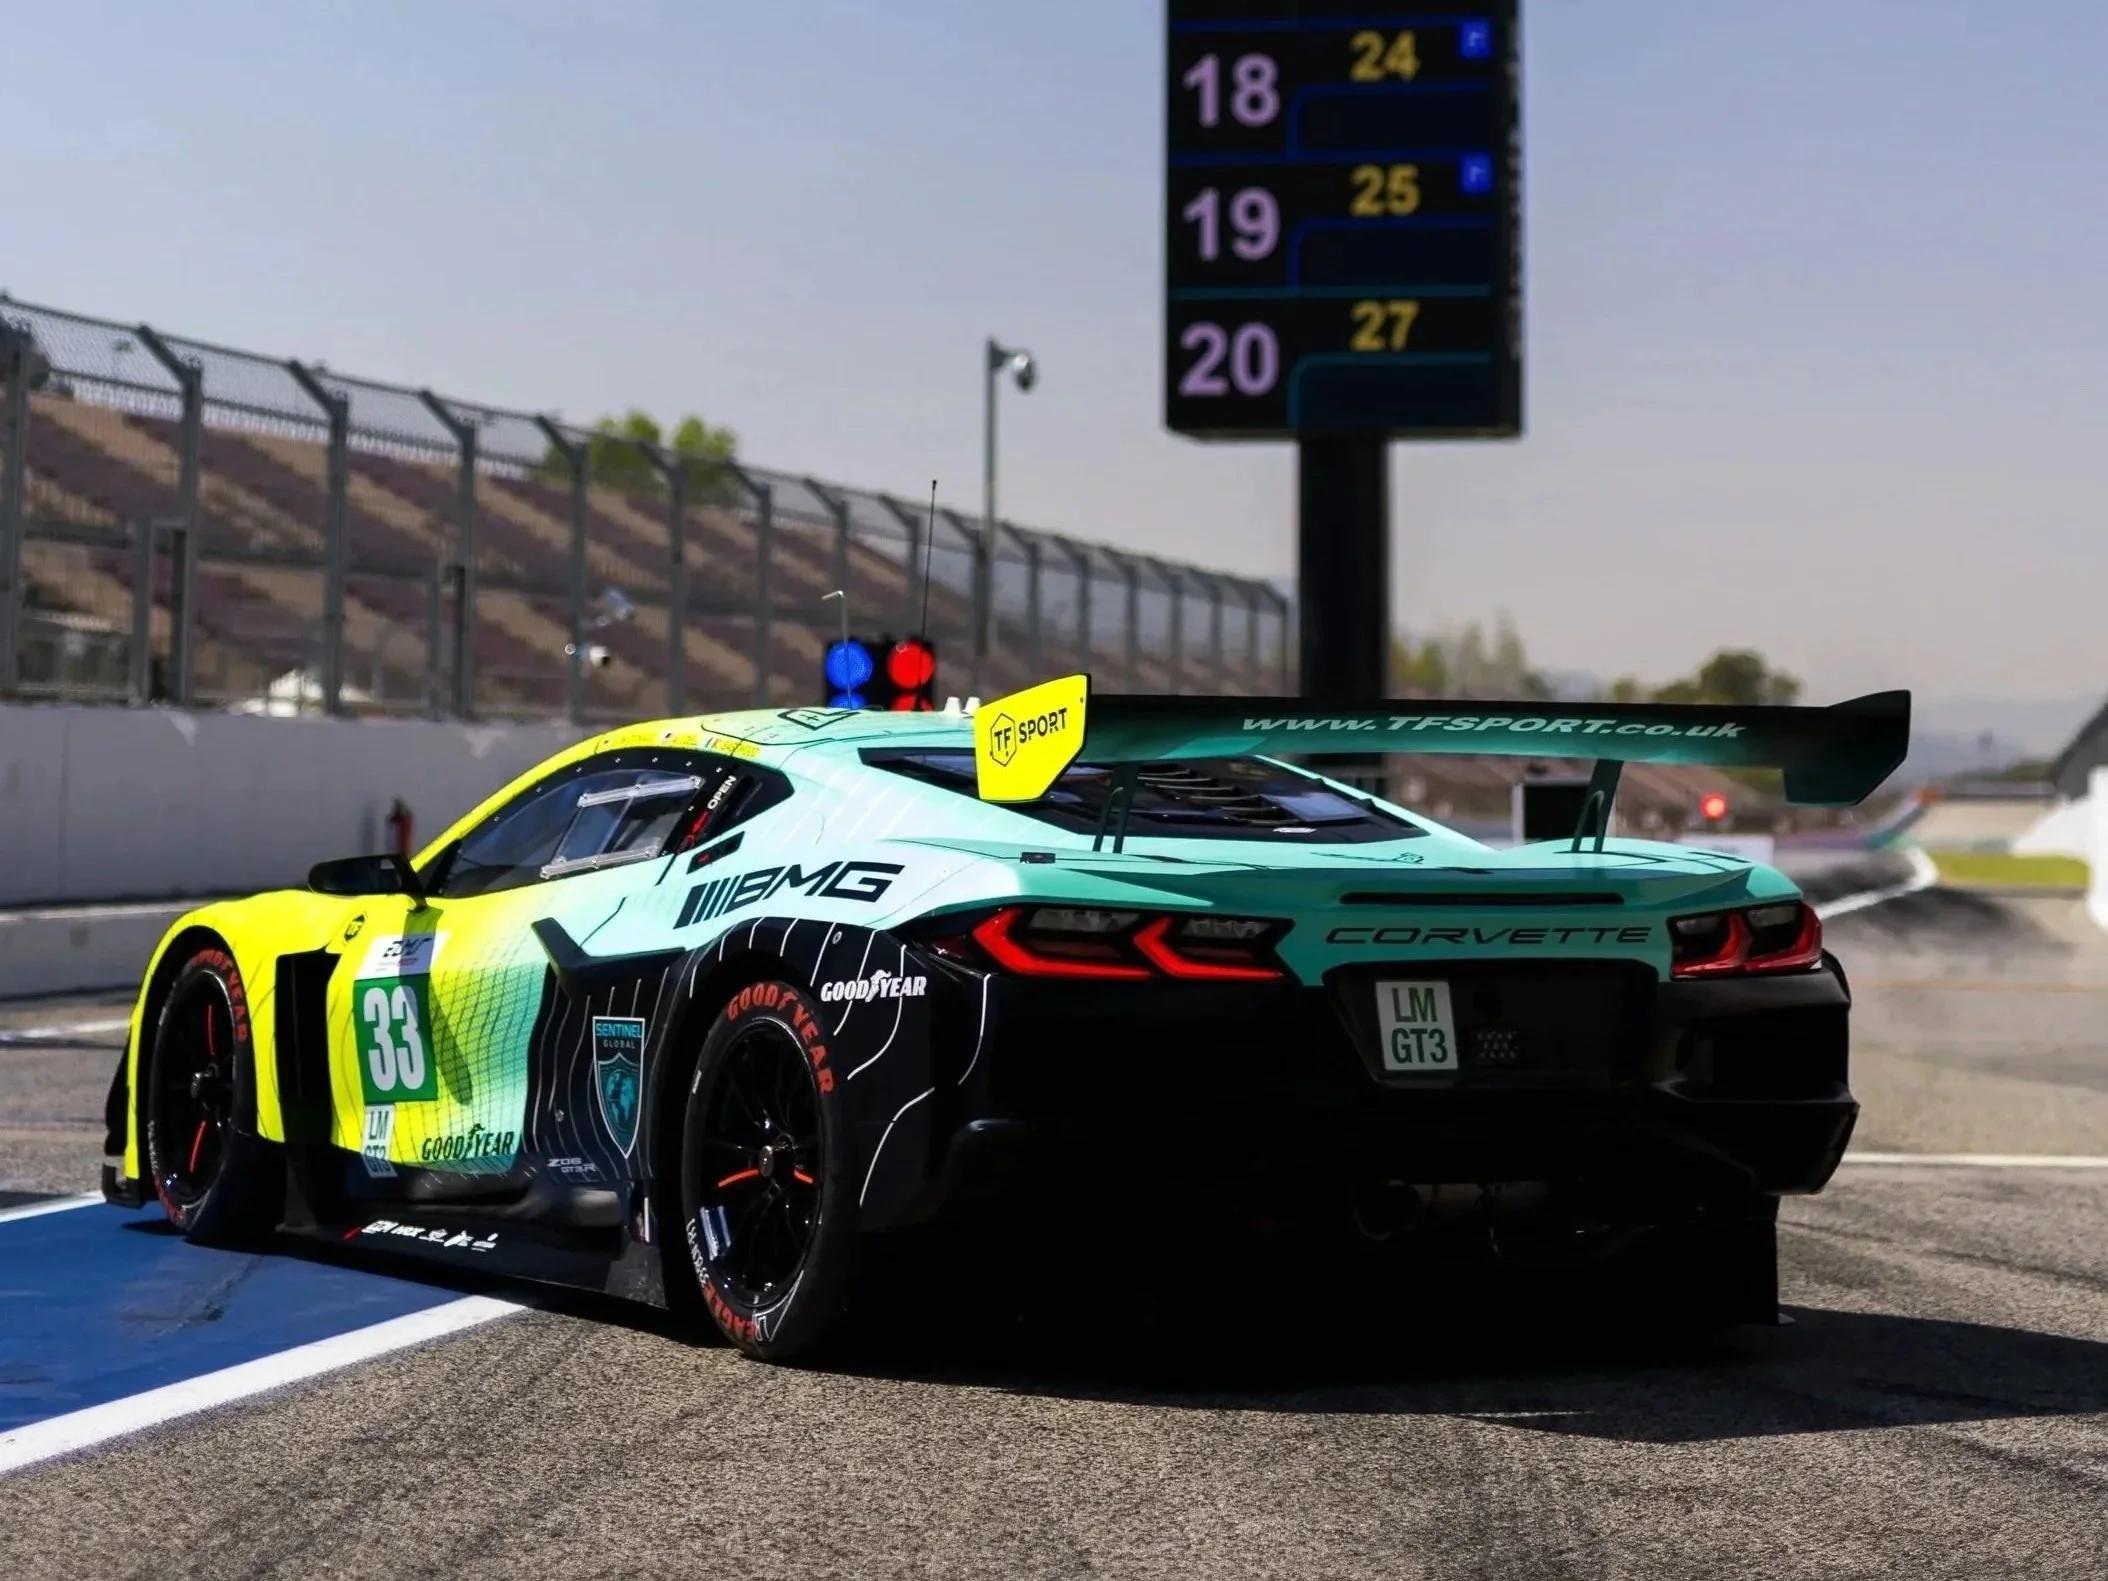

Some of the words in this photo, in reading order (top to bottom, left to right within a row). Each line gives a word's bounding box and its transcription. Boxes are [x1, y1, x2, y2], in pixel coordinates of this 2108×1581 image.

[1350, 30, 1420, 81] 24
[1182, 52, 1281, 127] 18
[1350, 165, 1421, 216] 25
[1182, 187, 1281, 261] 19
[1350, 300, 1420, 351] 27
[1178, 321, 1281, 396] 20
[1018, 707, 1068, 744] SPORT
[707, 775, 737, 810] OPEN
[1325, 926, 1653, 945] CORVETTE
[821, 969, 928, 1002] GOODYEAR
[1391, 986, 1438, 1023] LM
[363, 986, 426, 1092] 33
[595, 1023, 643, 1038] SENTINEL
[603, 1039, 637, 1049] GLOBAL
[1391, 1027, 1449, 1064] GT3
[421, 1125, 515, 1161] GOODYEAR
